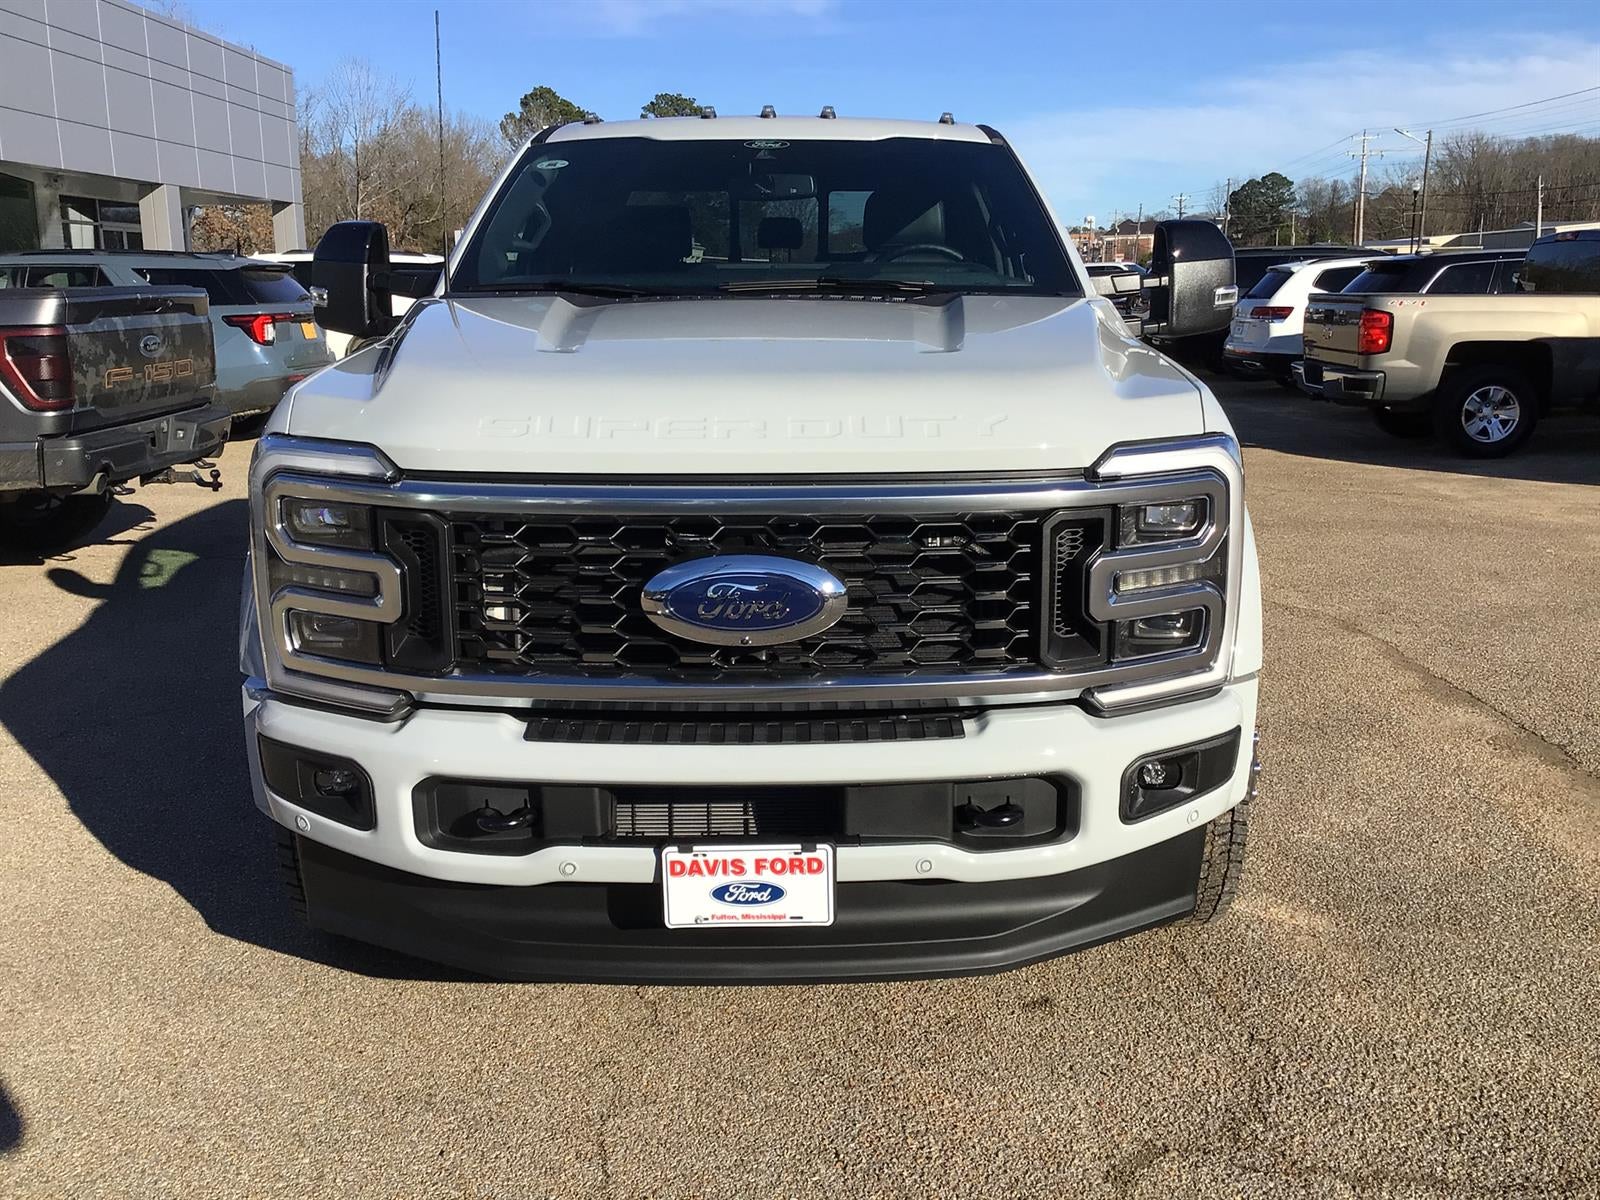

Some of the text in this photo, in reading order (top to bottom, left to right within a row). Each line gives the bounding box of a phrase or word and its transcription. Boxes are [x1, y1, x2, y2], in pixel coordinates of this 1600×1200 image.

[105, 358, 193, 389] F-150
[476, 413, 1010, 440] SUPER DUTY
[697, 582, 792, 620] Ford
[669, 857, 825, 877] DAVIS FORD
[724, 883, 772, 902] Ford
